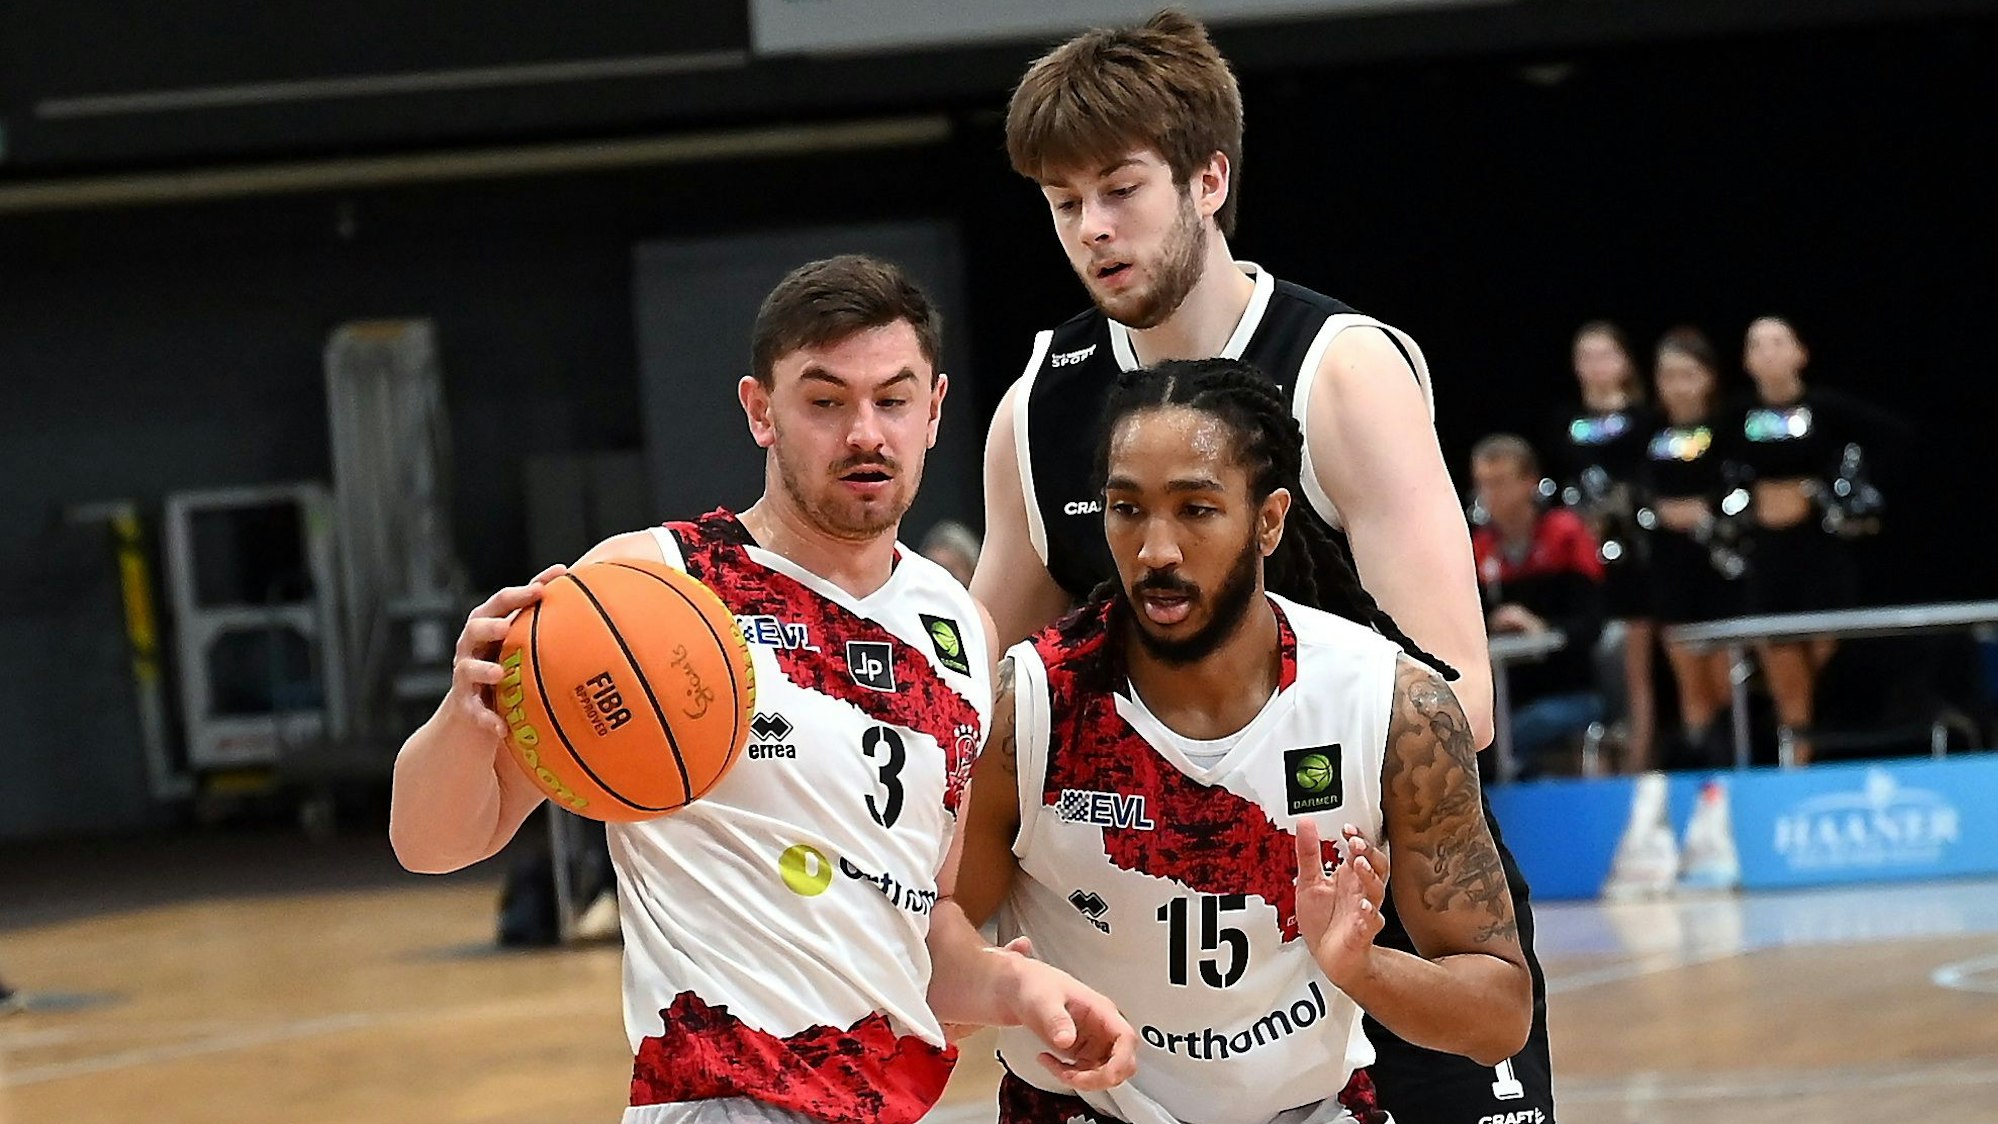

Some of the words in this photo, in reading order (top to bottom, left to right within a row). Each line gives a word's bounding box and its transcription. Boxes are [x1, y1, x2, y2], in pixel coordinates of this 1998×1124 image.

[1063, 500, 1102, 516] CRA
[753, 616, 821, 653] EVL
[574, 684, 608, 737] APPROVED
[586, 671, 633, 730] FIBA
[748, 744, 797, 759] errea
[861, 725, 906, 829] 3
[1090, 792, 1154, 829] EVL
[1156, 894, 1249, 989] 15
[1141, 981, 1326, 1060] orthomol
